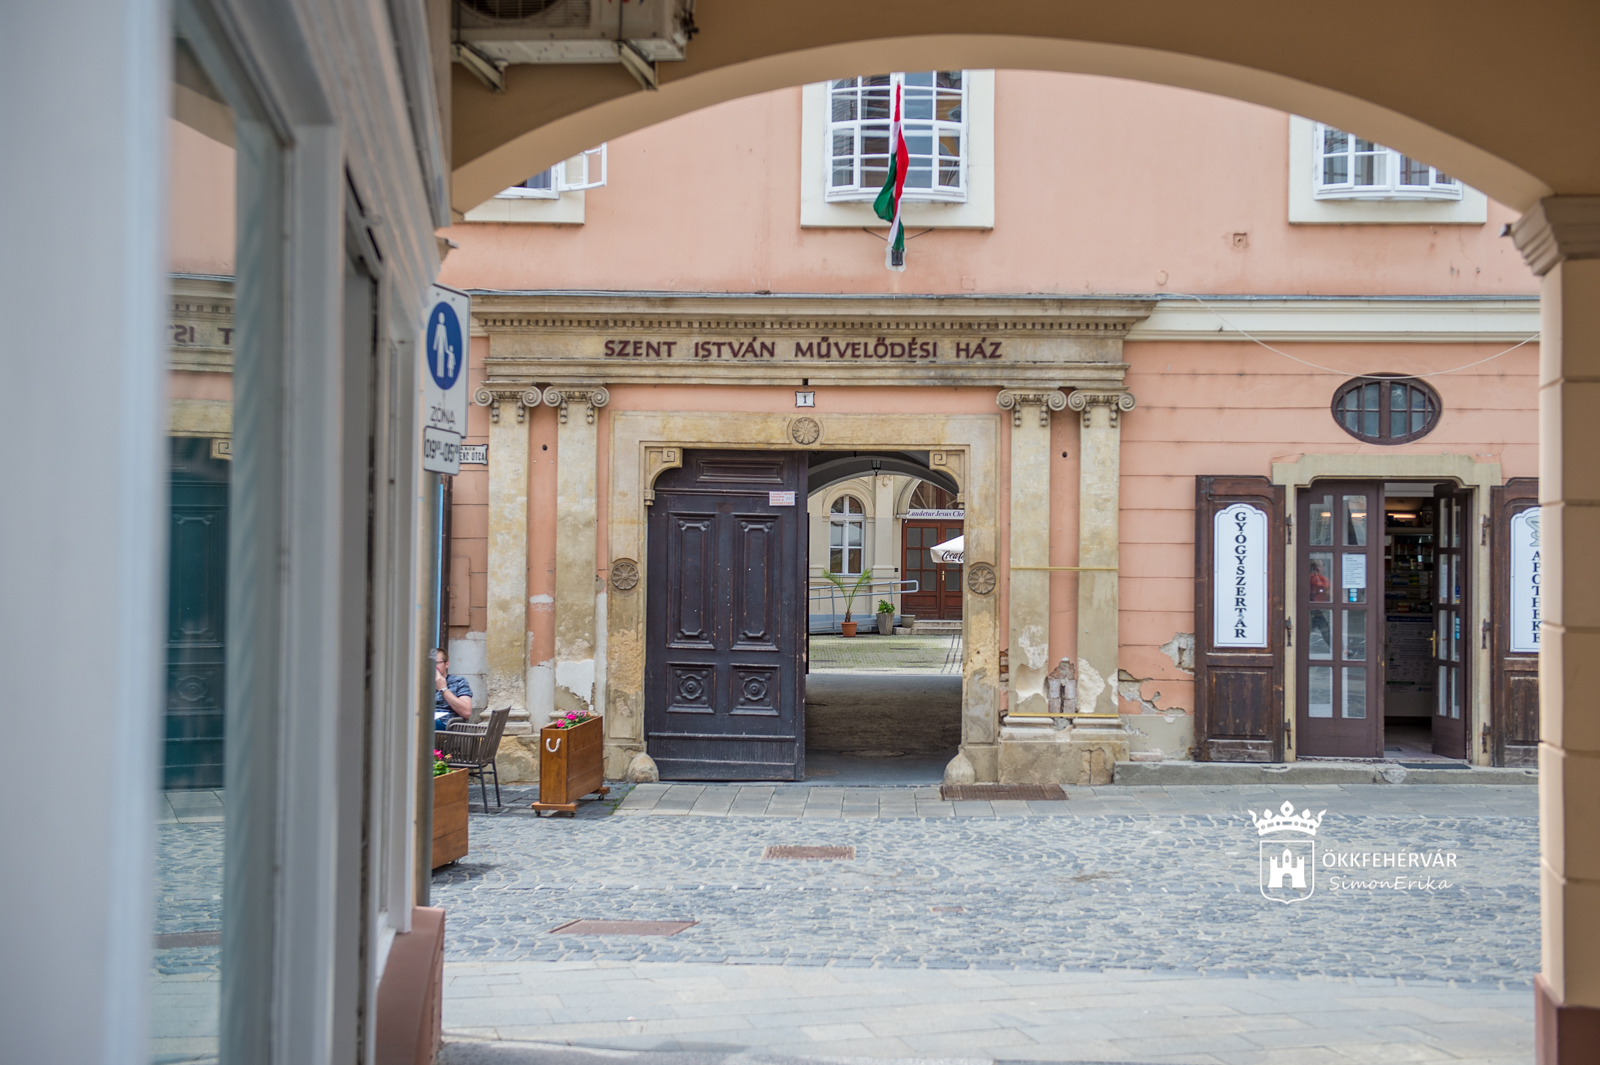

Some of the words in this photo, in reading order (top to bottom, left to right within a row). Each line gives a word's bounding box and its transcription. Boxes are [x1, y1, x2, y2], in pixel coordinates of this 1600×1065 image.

[604, 339, 677, 358] SZENT
[694, 336, 776, 358] ISTVÁN
[794, 336, 938, 359] MŰVELŐDÉSI
[955, 336, 1003, 359] HÁZ
[1234, 511, 1247, 639] GYÓGYSZERTÁR
